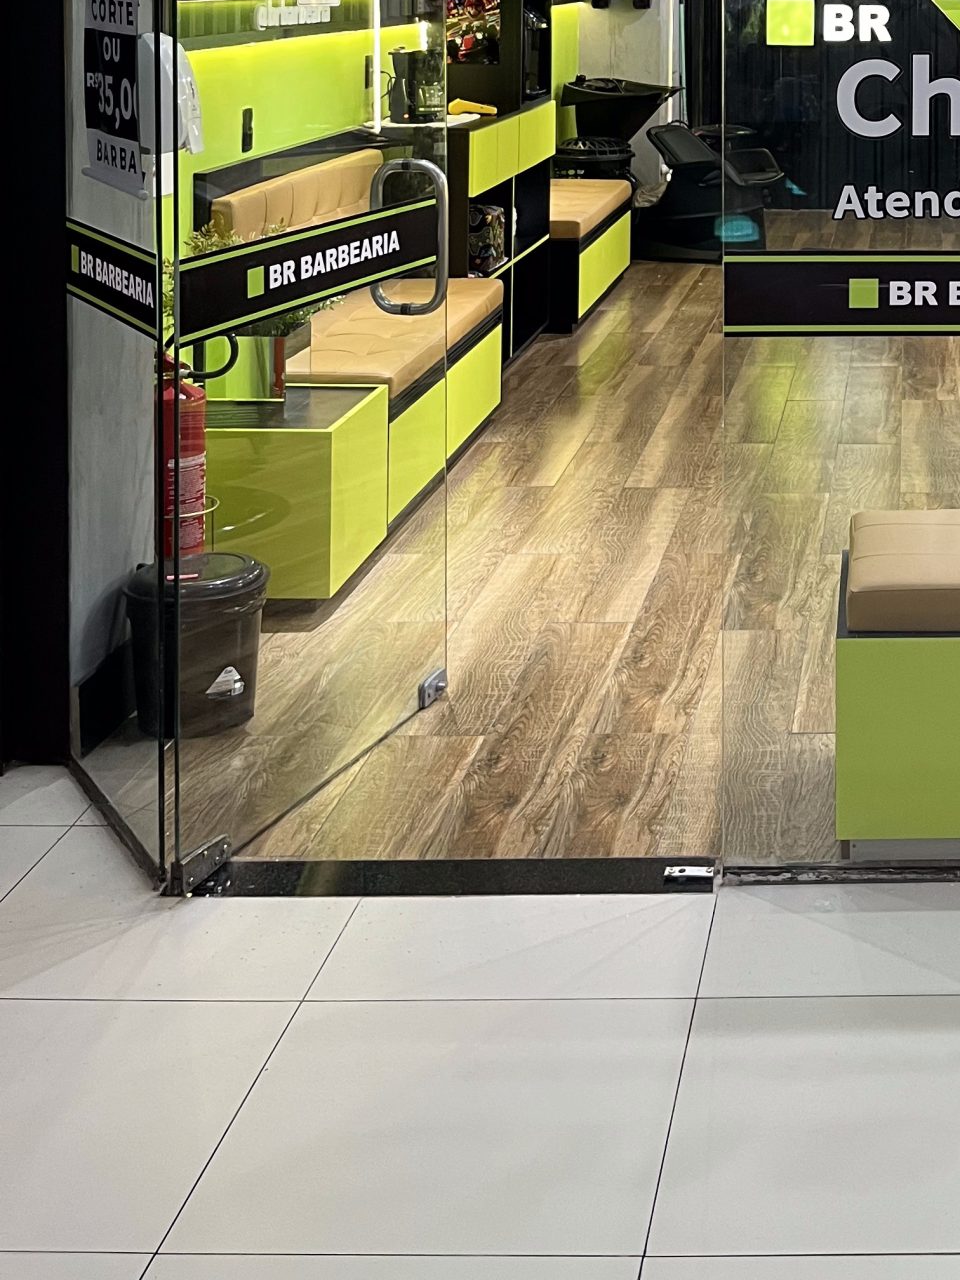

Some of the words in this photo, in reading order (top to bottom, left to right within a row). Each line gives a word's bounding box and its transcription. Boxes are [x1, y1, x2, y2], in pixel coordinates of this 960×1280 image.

[822, 4, 893, 43] BR
[103, 36, 121, 63] OU
[96, 138, 138, 174] BARBA
[269, 260, 297, 290] BR
[300, 230, 401, 281] BARBEARIA
[80, 250, 95, 279] BR
[95, 257, 155, 309] BARBEARIA
[888, 280, 938, 307] BR
